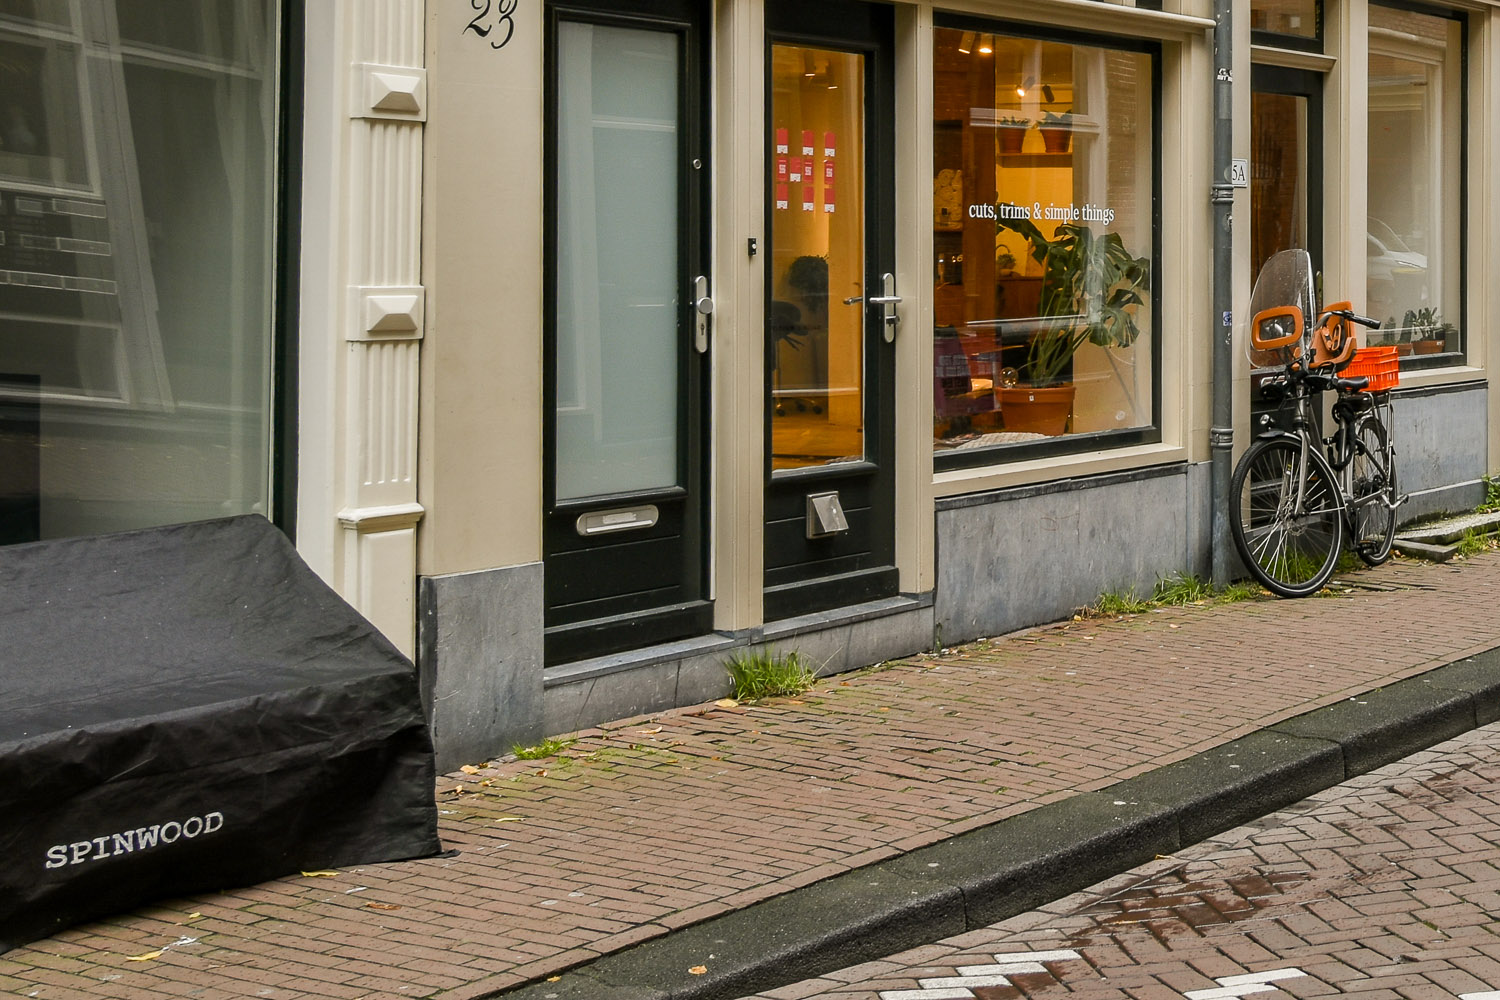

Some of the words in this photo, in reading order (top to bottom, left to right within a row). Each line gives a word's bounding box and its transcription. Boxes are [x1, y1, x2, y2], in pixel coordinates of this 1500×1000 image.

[968, 202, 998, 221] cuts,
[1000, 201, 1031, 220] trims
[1033, 202, 1043, 220] &
[1045, 202, 1080, 225] simple
[1082, 203, 1115, 226] things
[45, 811, 224, 869] SPINWOOD
